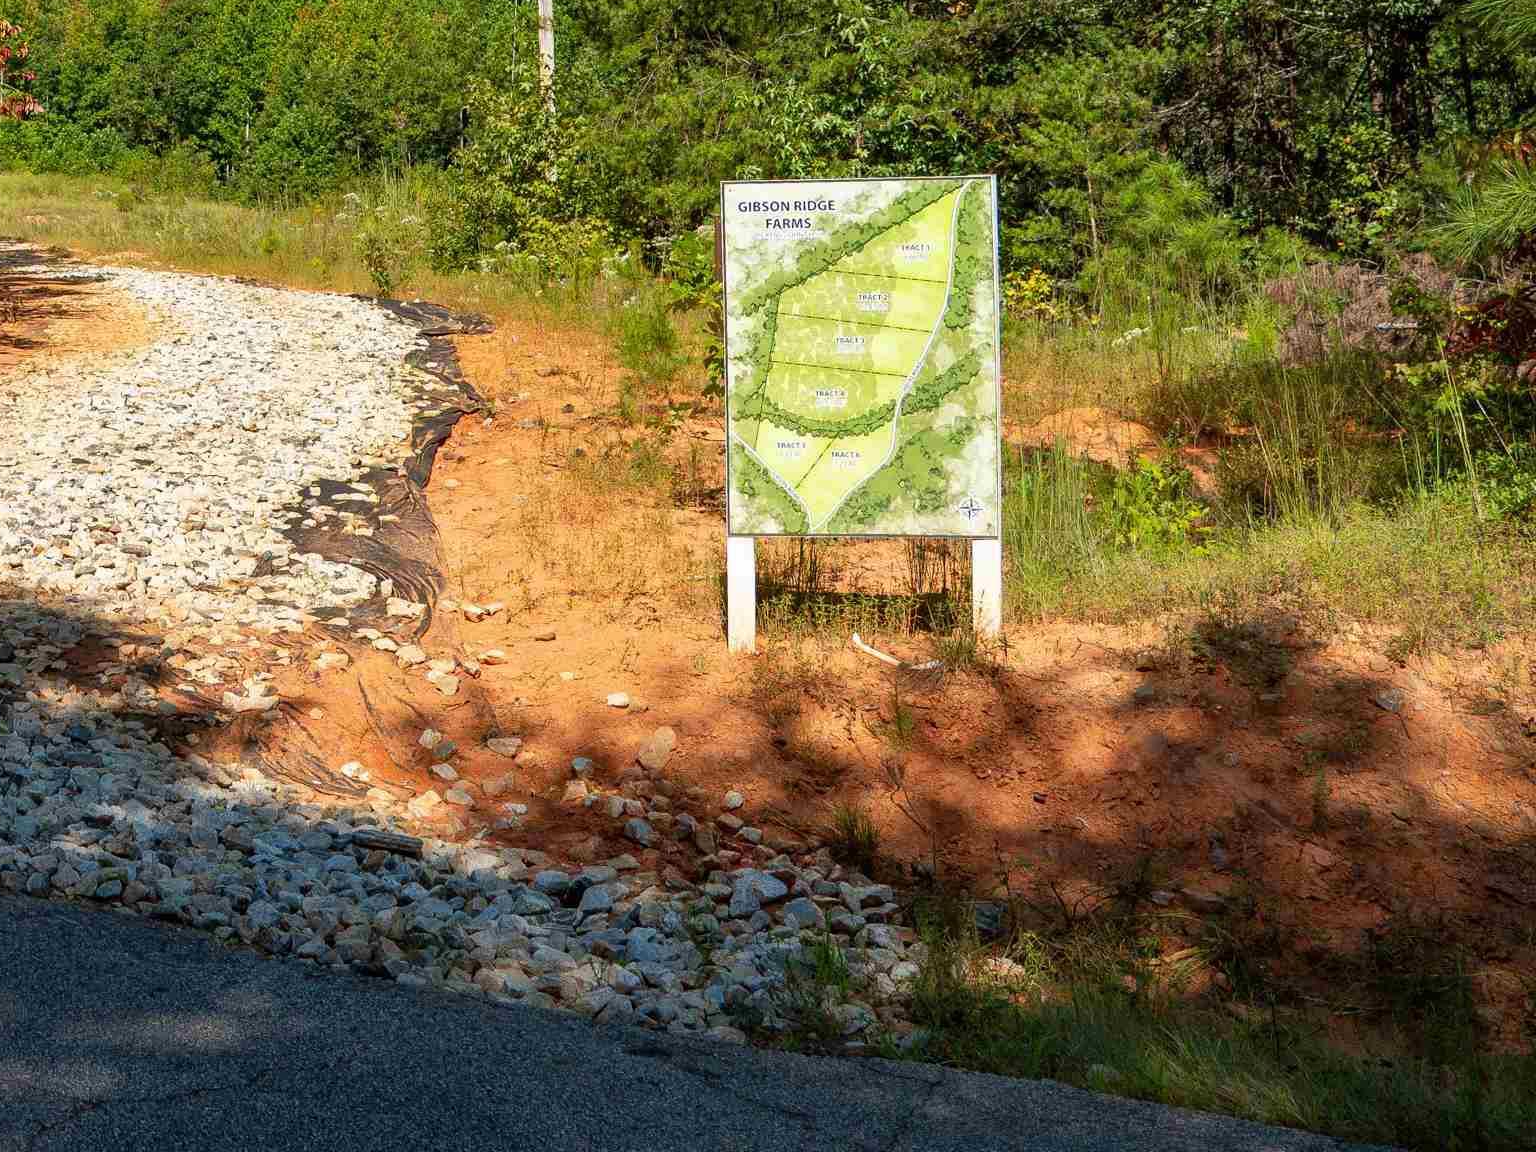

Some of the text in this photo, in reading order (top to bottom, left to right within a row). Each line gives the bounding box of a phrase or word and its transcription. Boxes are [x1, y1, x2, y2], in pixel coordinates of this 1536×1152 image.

[737, 199, 836, 213] GIBSON RIDGE
[765, 217, 812, 230] FARMS
